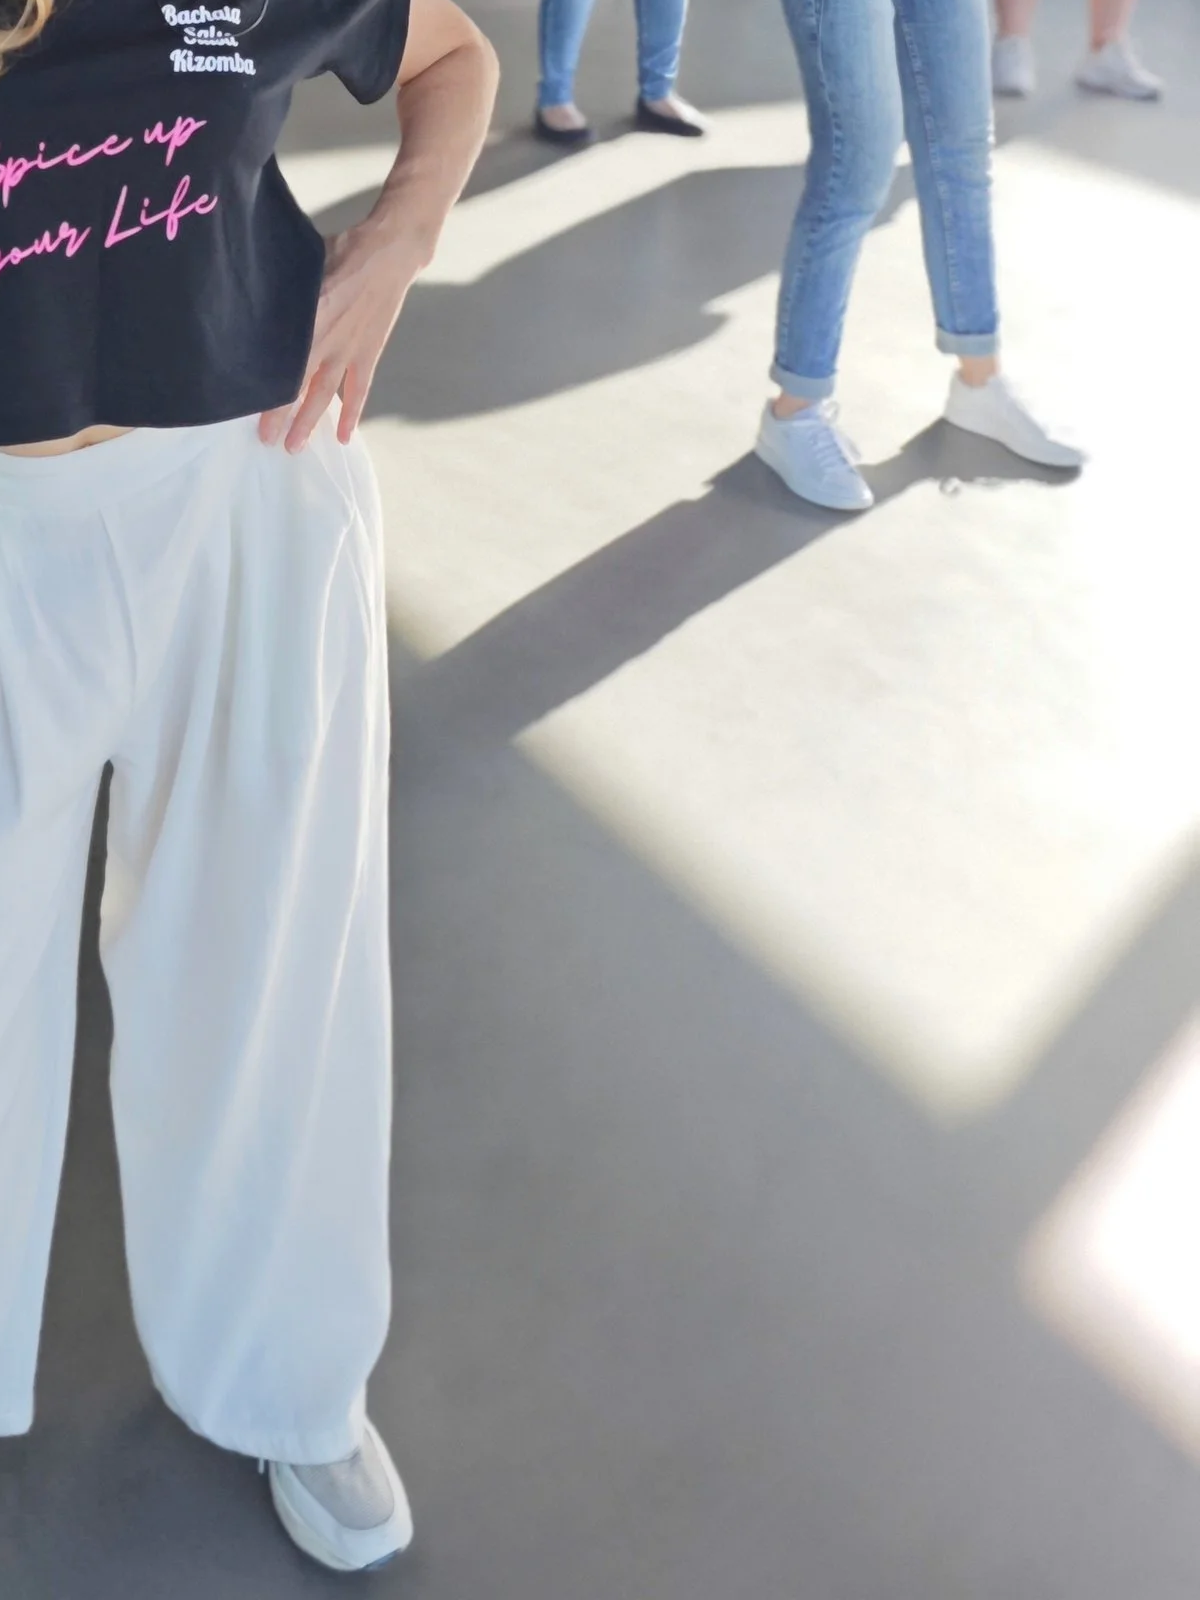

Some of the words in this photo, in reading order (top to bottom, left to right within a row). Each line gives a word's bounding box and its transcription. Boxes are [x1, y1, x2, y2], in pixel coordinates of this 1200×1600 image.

[169, 48, 257, 76] Kizomba
[143, 116, 207, 166] up
[104, 175, 219, 248] Life
